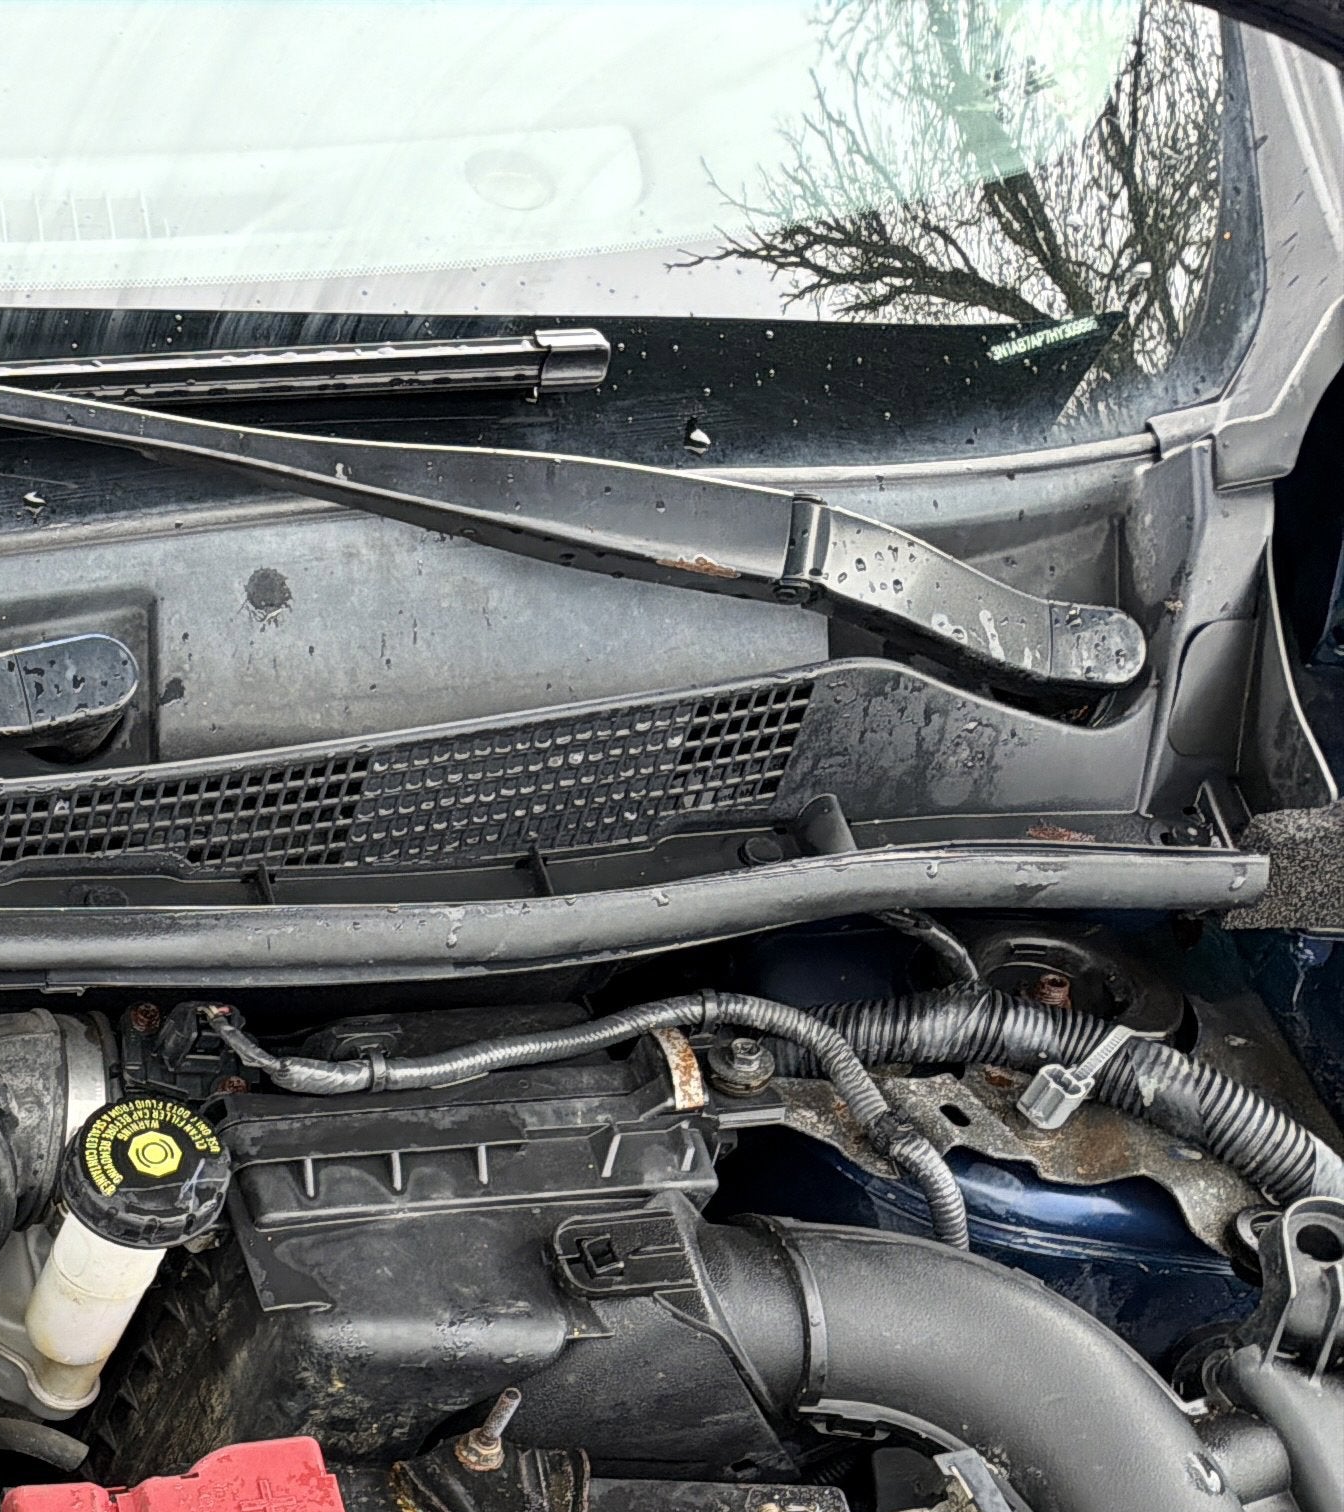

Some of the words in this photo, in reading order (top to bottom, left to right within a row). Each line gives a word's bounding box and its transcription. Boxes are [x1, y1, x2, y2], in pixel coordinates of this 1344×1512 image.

[107, 1101, 135, 1118] FROM
[132, 1109, 150, 1120] CAP
[134, 1099, 163, 1110] FLUID
[101, 1114, 111, 1122] A
[101, 1113, 133, 1141] BEFORE
[152, 1109, 187, 1128] FILLER
[85, 1119, 107, 1149] SEALED
[117, 1119, 160, 1142] WARNING
[183, 1123, 208, 1151] CLEAN
[206, 1136, 221, 1153] USE
[85, 1149, 116, 1197] CONTAINER
[98, 1140, 124, 1186] REMOVING
